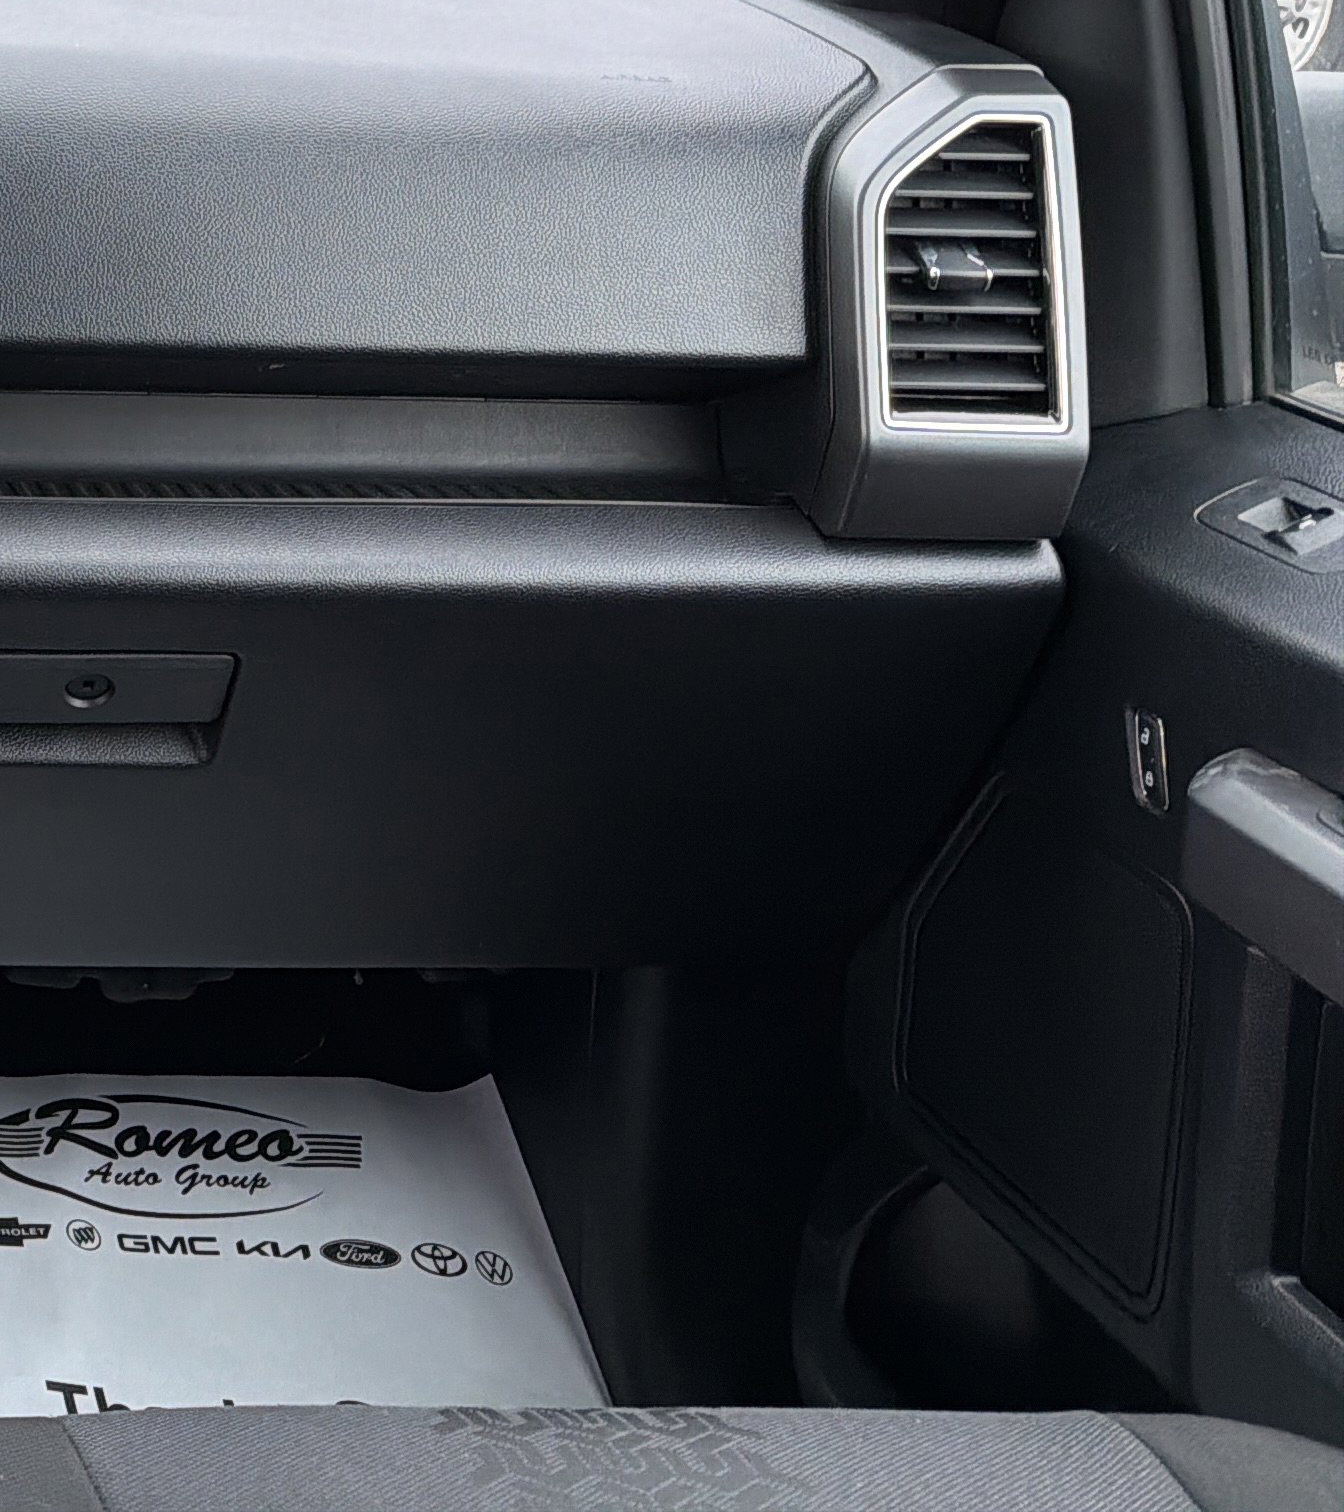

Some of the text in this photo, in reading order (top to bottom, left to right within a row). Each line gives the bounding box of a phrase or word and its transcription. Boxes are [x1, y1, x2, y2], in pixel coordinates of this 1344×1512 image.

[35, 1098, 306, 1162] Romeo
[84, 1161, 271, 1195] Auto Group
[117, 1234, 220, 1256] GMC
[336, 1242, 386, 1265] Ford
